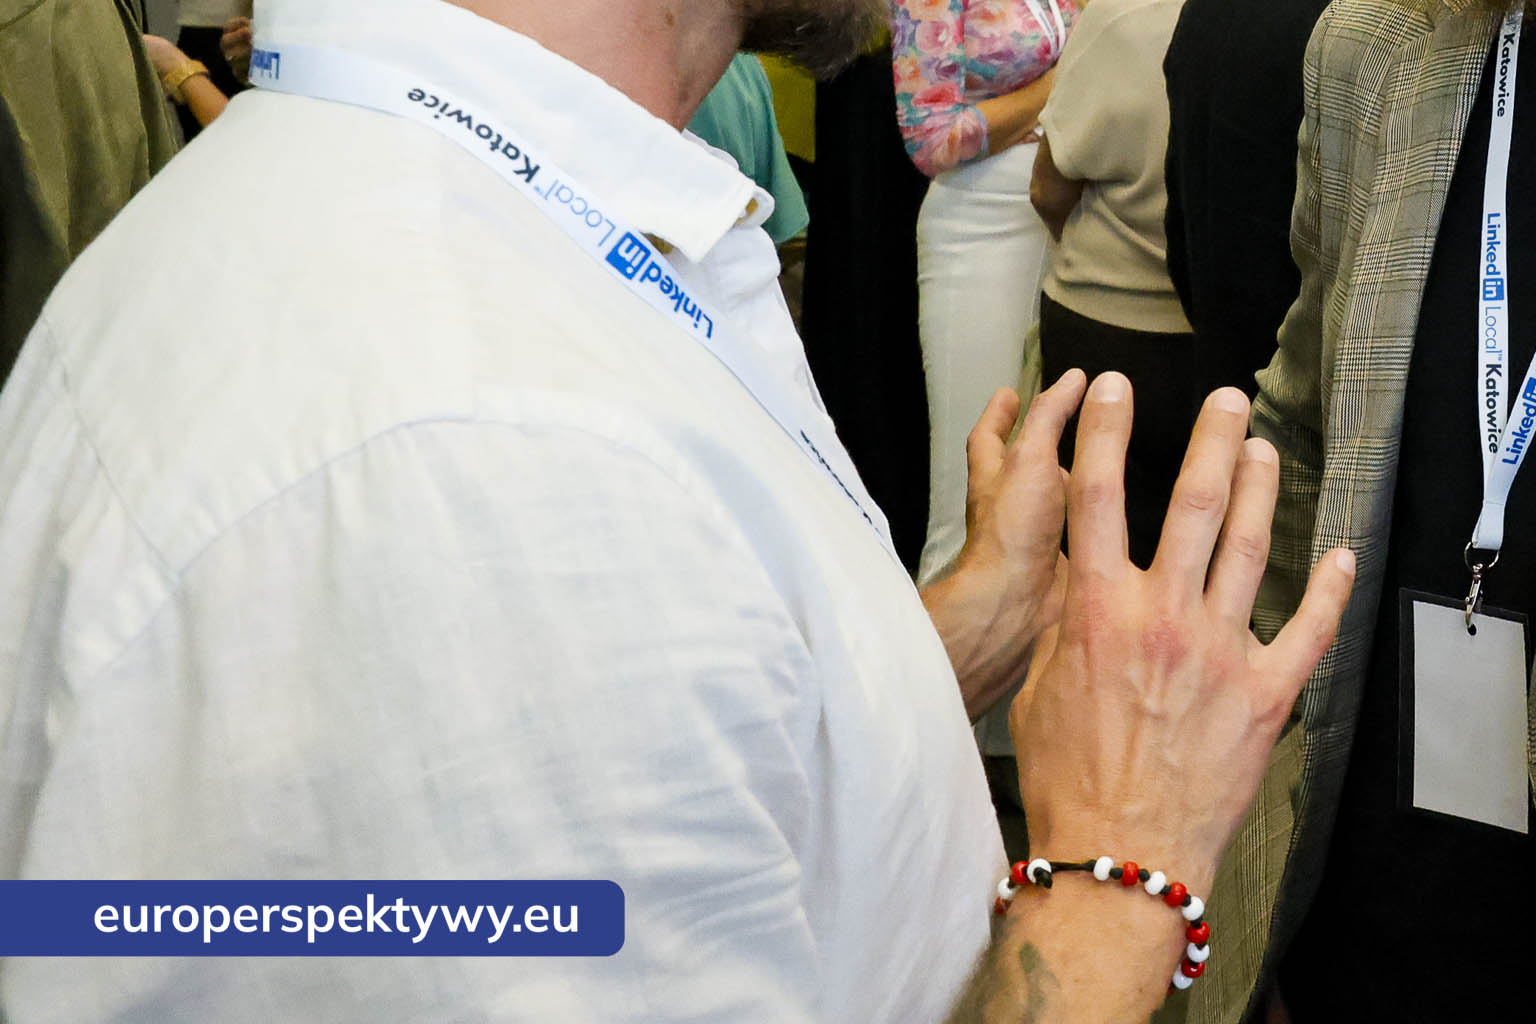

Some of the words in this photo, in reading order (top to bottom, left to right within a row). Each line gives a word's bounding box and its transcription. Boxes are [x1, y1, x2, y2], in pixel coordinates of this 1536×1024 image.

[1497, 33, 1516, 117] Katowice
[407, 87, 541, 184] Katowice
[1485, 363, 1502, 454] Katowice
